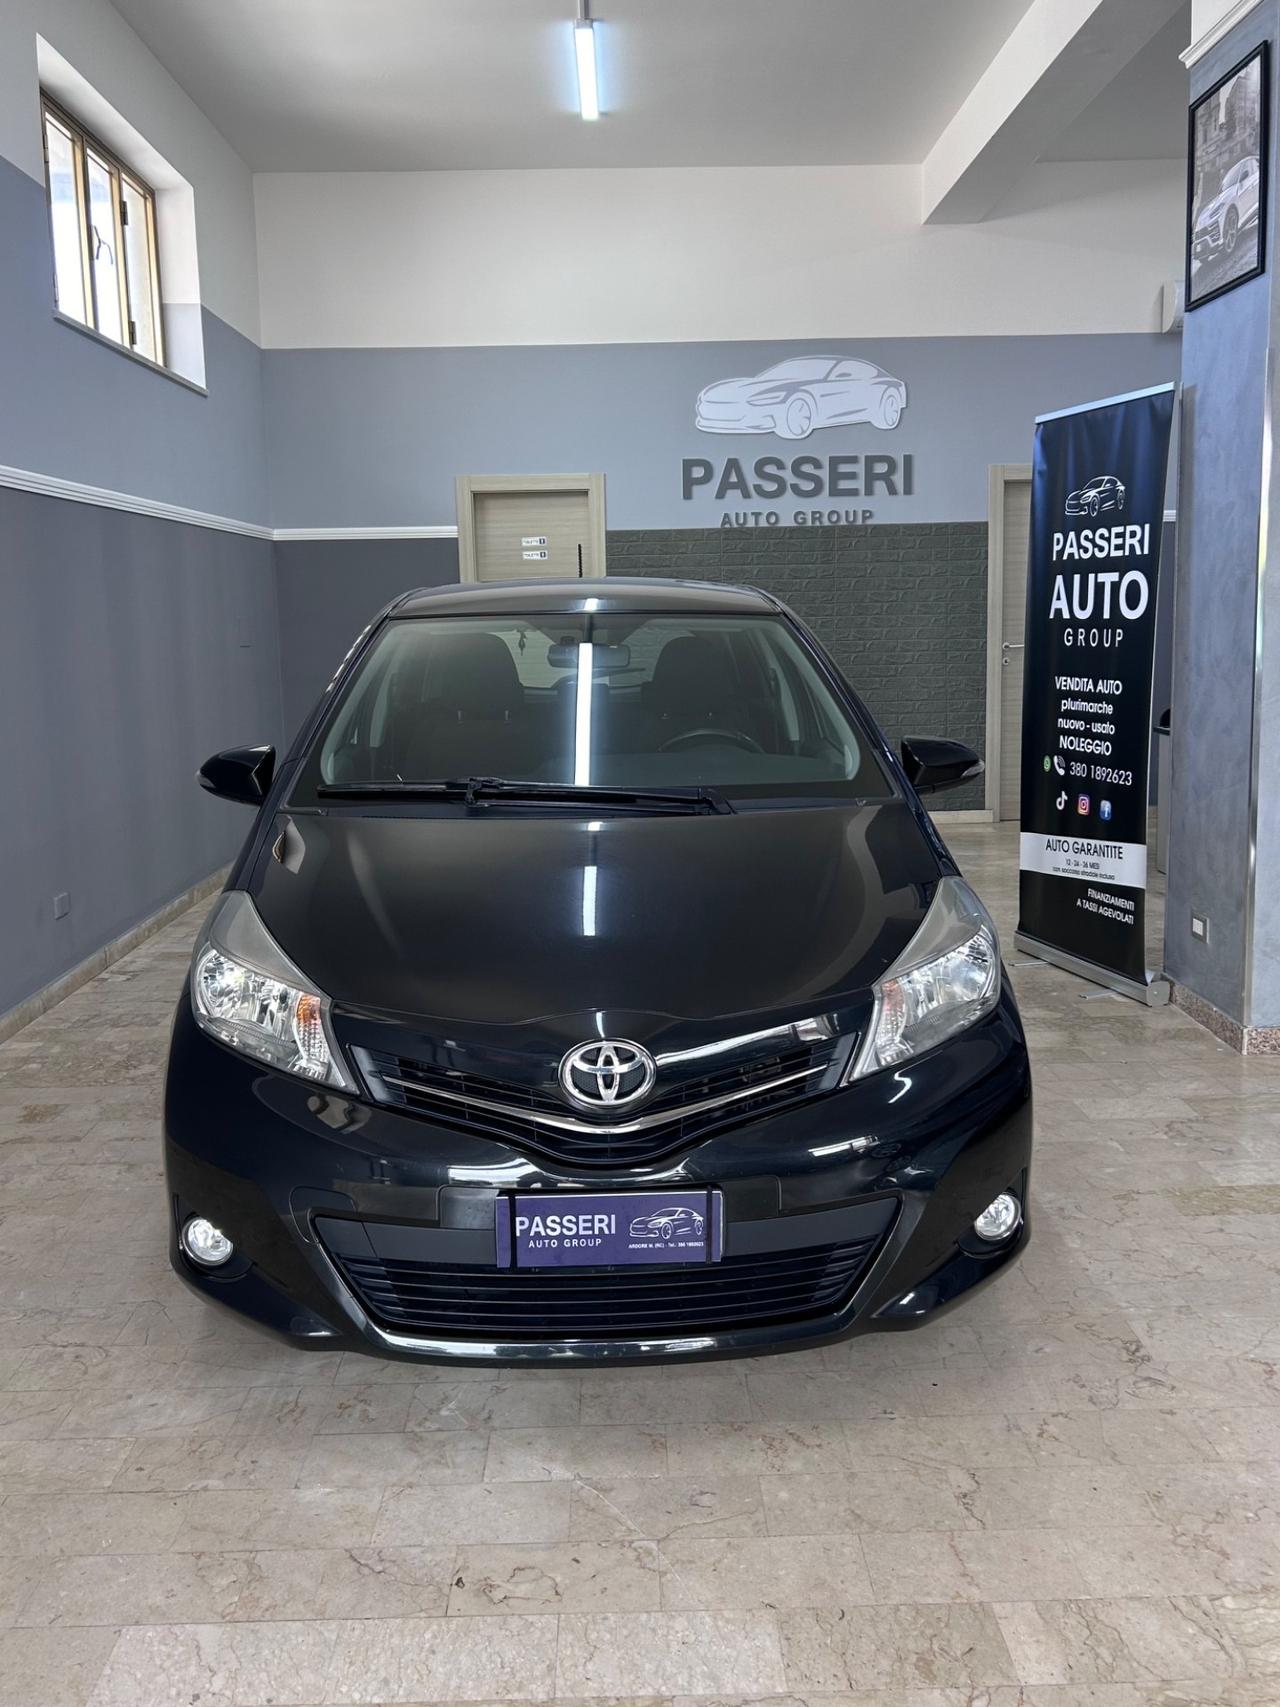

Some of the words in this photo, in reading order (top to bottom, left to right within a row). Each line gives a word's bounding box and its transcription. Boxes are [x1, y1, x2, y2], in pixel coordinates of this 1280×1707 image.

[682, 454, 914, 501] PASSERI
[720, 510, 780, 528] AUTO
[793, 509, 874, 526] GROUP
[1052, 523, 1150, 561] PASSERI
[1049, 570, 1149, 620] AUTO
[1064, 628, 1124, 648] GROUP
[1055, 676, 1094, 693] VENDITA
[1096, 679, 1123, 695] AUTO
[1061, 697, 1114, 715] plurimarche
[1057, 718, 1085, 731] nuovo
[1091, 720, 1116, 735] usato
[1059, 735, 1112, 756] NOLEGGIO
[1069, 761, 1087, 778] 380
[1090, 764, 1133, 786] 1892623
[1045, 838, 1070, 853] AUTO
[1072, 841, 1123, 860] GARANTITE
[1087, 888, 1135, 911] FINANZIAMENTI
[1076, 898, 1082, 907] A
[1082, 899, 1098, 912] TASSI
[1098, 906, 1134, 925] AGEVOLATI
[515, 1214, 616, 1237] PASSERI
[528, 1238, 558, 1248] AUTO
[563, 1238, 602, 1248] GROUP
